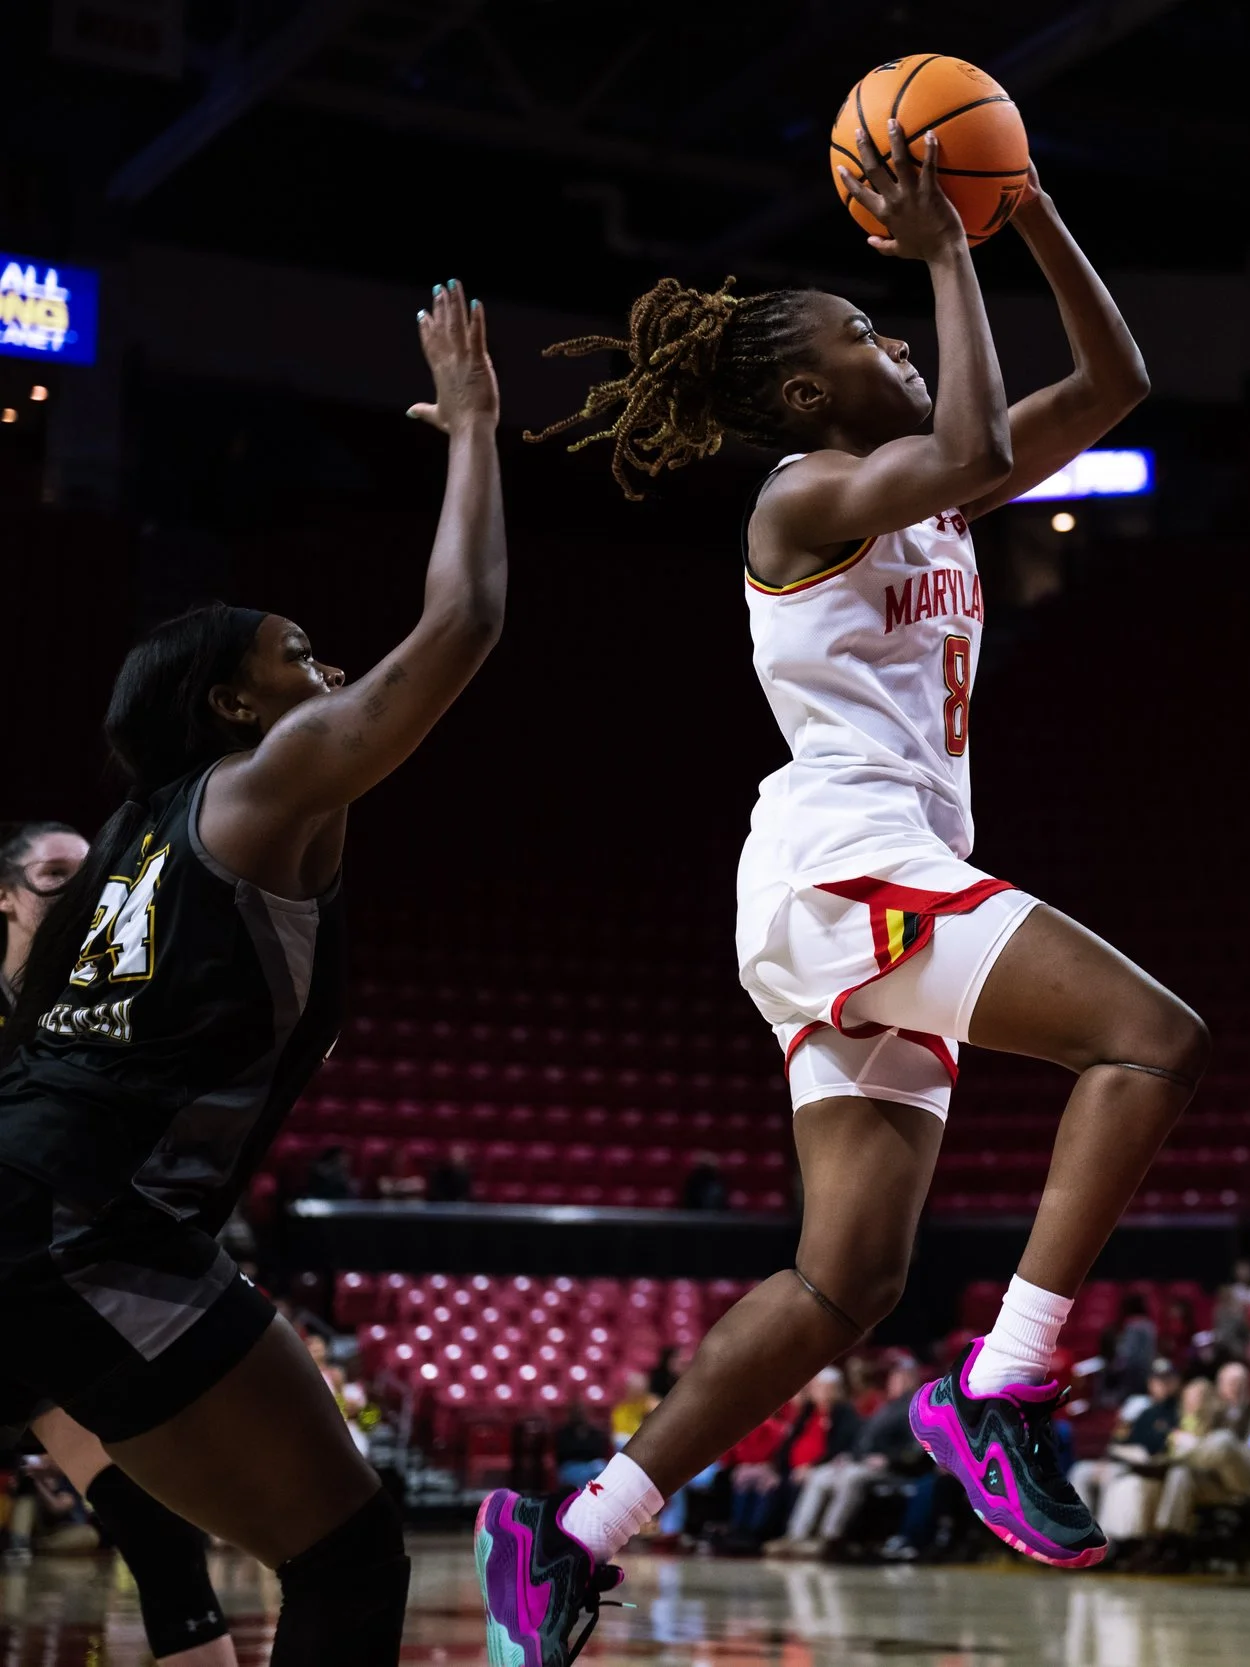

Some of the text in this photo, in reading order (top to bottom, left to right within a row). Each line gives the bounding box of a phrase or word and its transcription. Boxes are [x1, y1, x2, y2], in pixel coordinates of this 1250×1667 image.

[0, 296, 69, 329] NG
[884, 568, 984, 635] MARYLA
[943, 634, 971, 757] 8
[69, 843, 170, 987] 24
